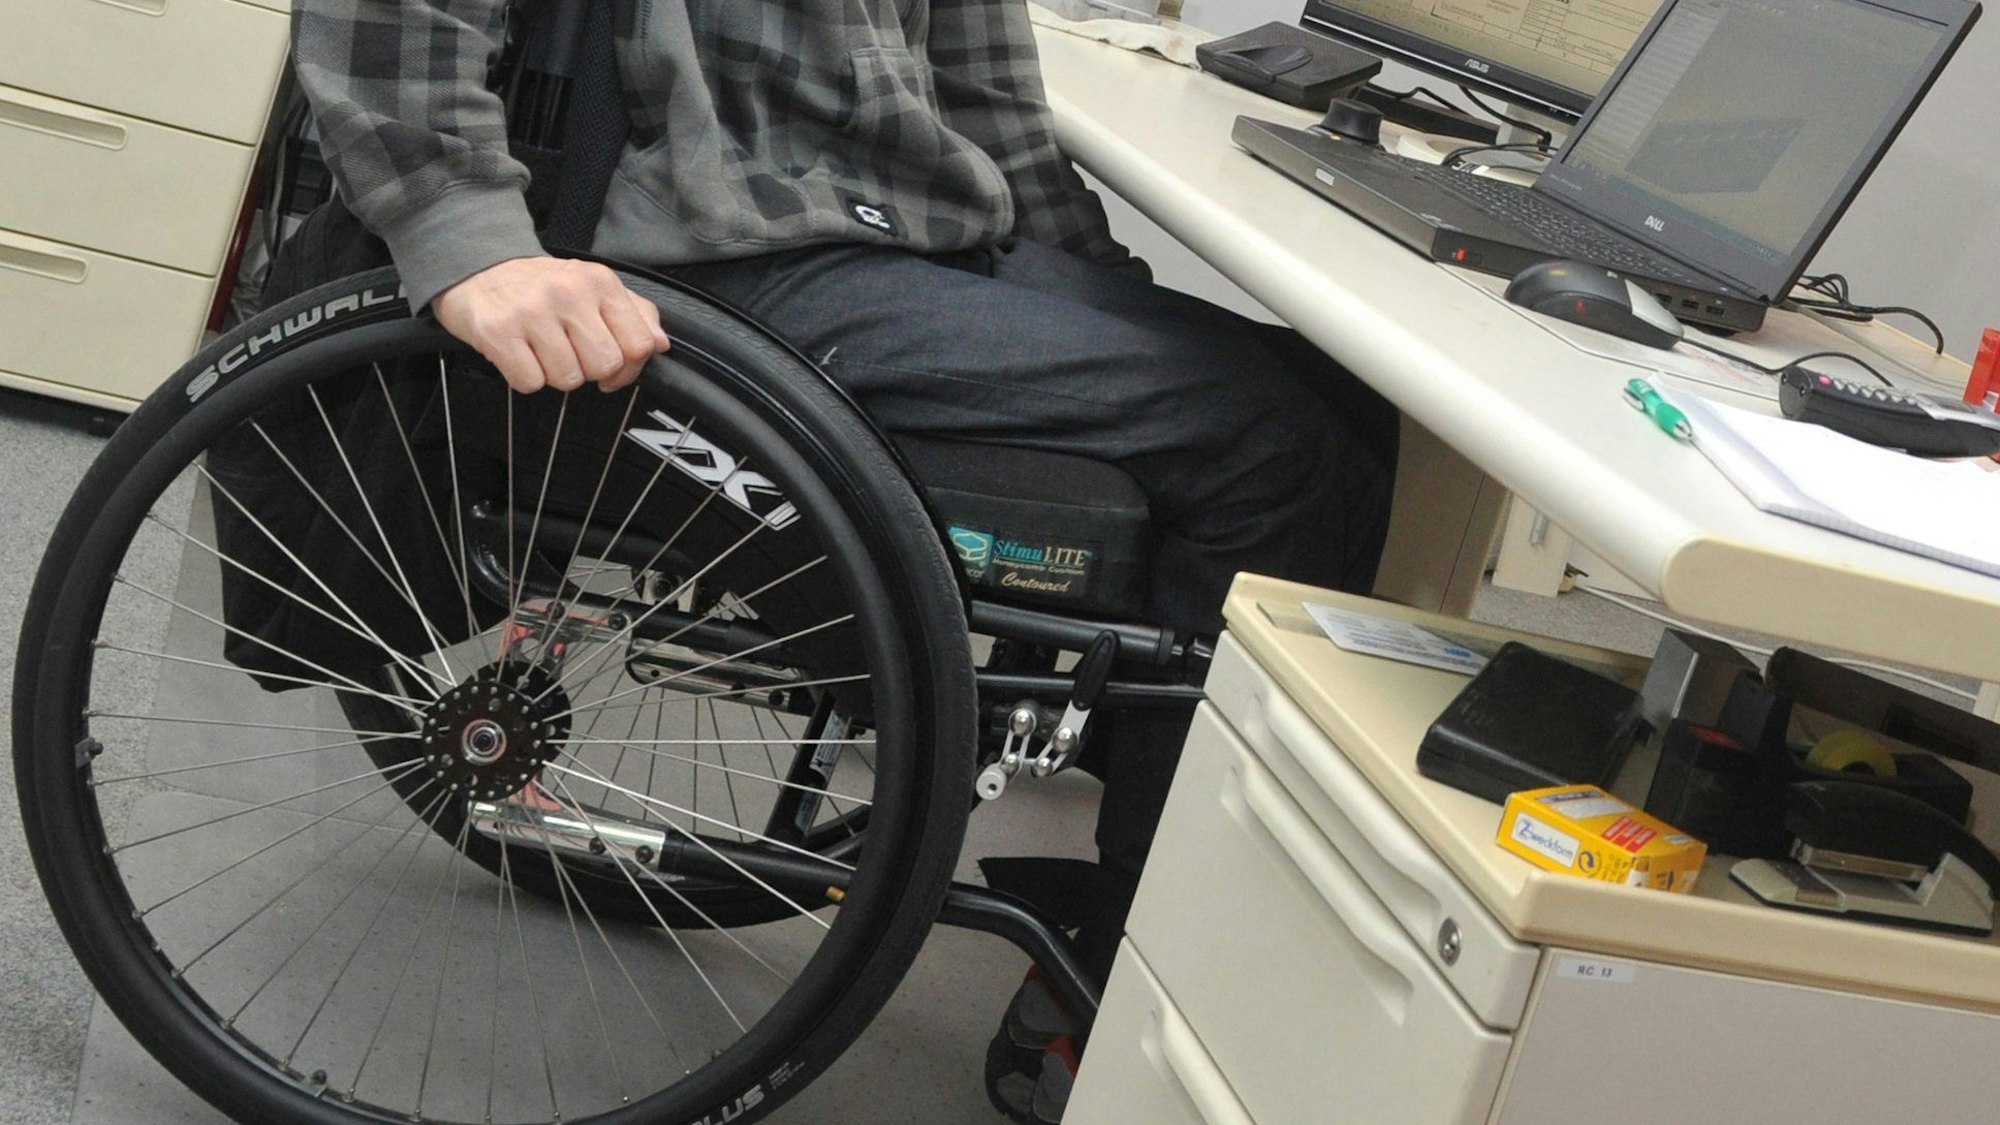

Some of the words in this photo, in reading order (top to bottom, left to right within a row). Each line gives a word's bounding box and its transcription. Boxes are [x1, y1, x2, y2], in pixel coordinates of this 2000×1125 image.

[1465, 58, 1490, 74] ASUS
[1644, 215, 1665, 232] DELL
[186, 284, 408, 403] SCHWAL
[1002, 572, 1071, 592] Contoured
